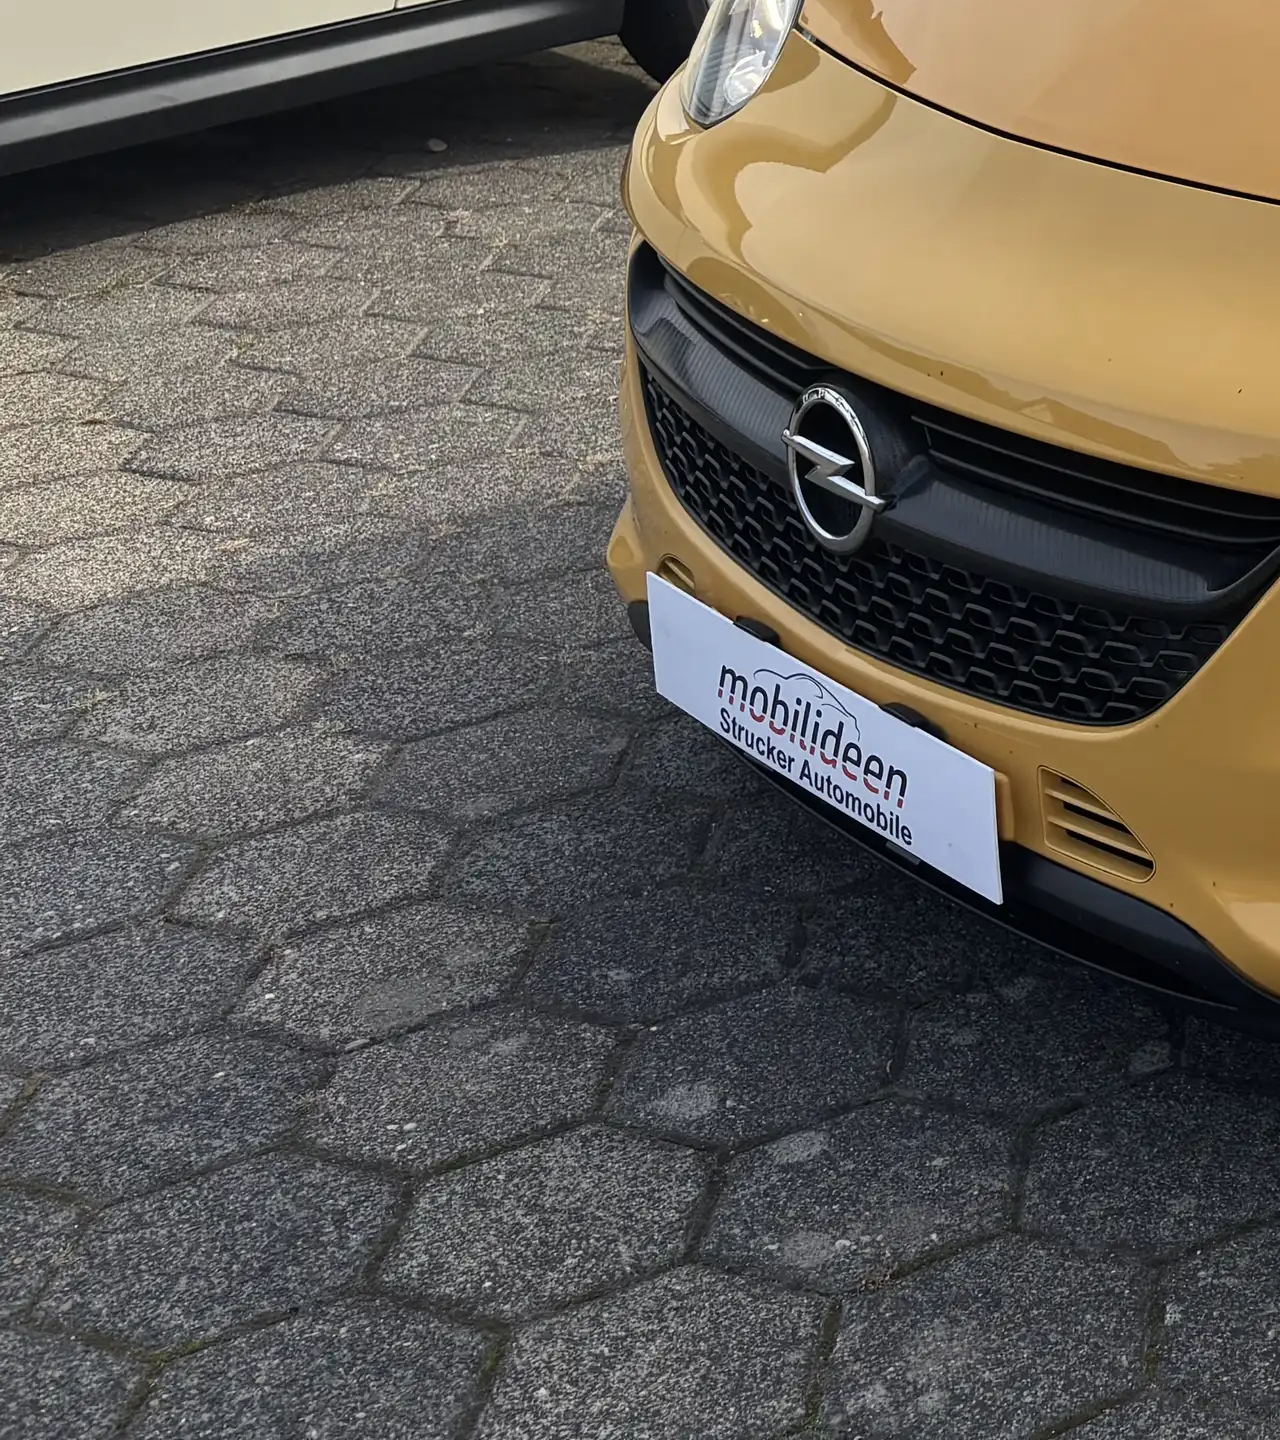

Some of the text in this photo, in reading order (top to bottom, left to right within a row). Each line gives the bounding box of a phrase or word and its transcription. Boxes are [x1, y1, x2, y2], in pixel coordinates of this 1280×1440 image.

[717, 663, 909, 810] mobilideen
[719, 706, 913, 846] Strucker Automobile
